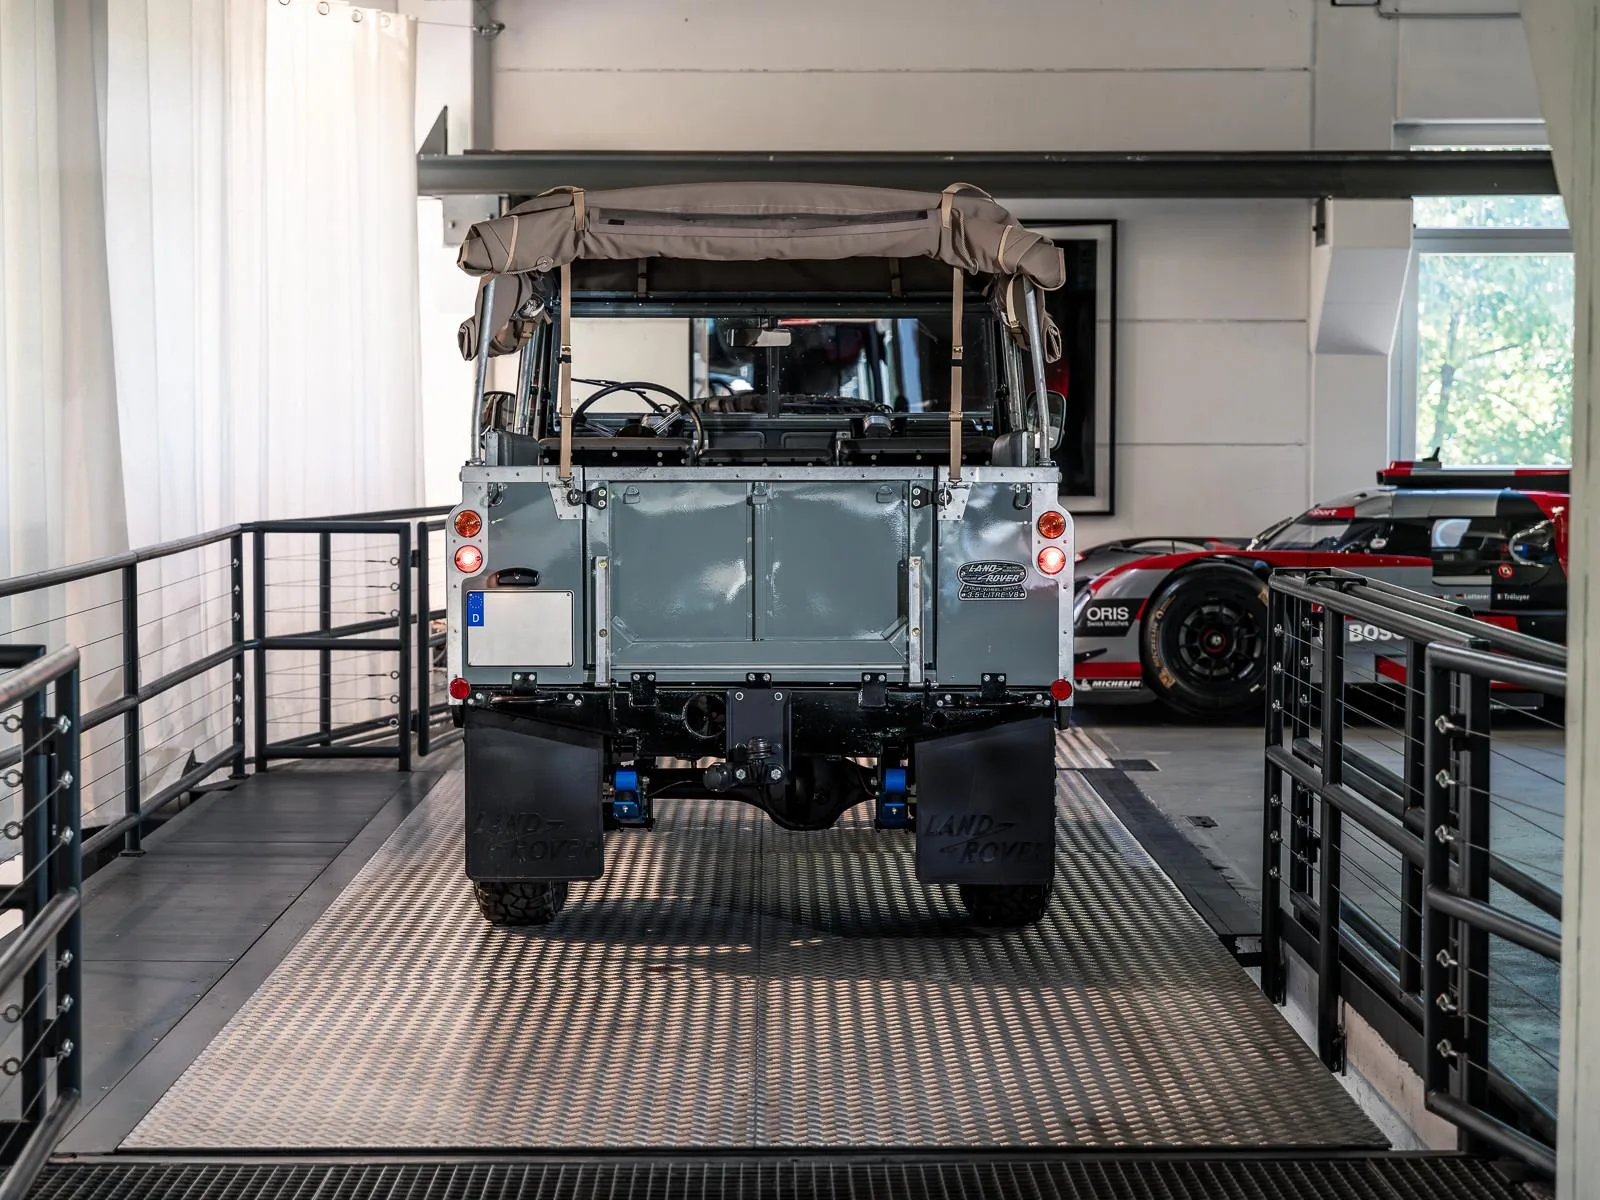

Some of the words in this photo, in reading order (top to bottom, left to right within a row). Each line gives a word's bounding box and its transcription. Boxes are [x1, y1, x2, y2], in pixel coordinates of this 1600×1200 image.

[969, 564, 997, 572] LAND
[986, 574, 1020, 582] ROVER
[472, 613, 480, 623] D
[1087, 607, 1129, 620] ORIS
[1092, 680, 1141, 688] MICHELIN
[925, 813, 994, 837] LAND
